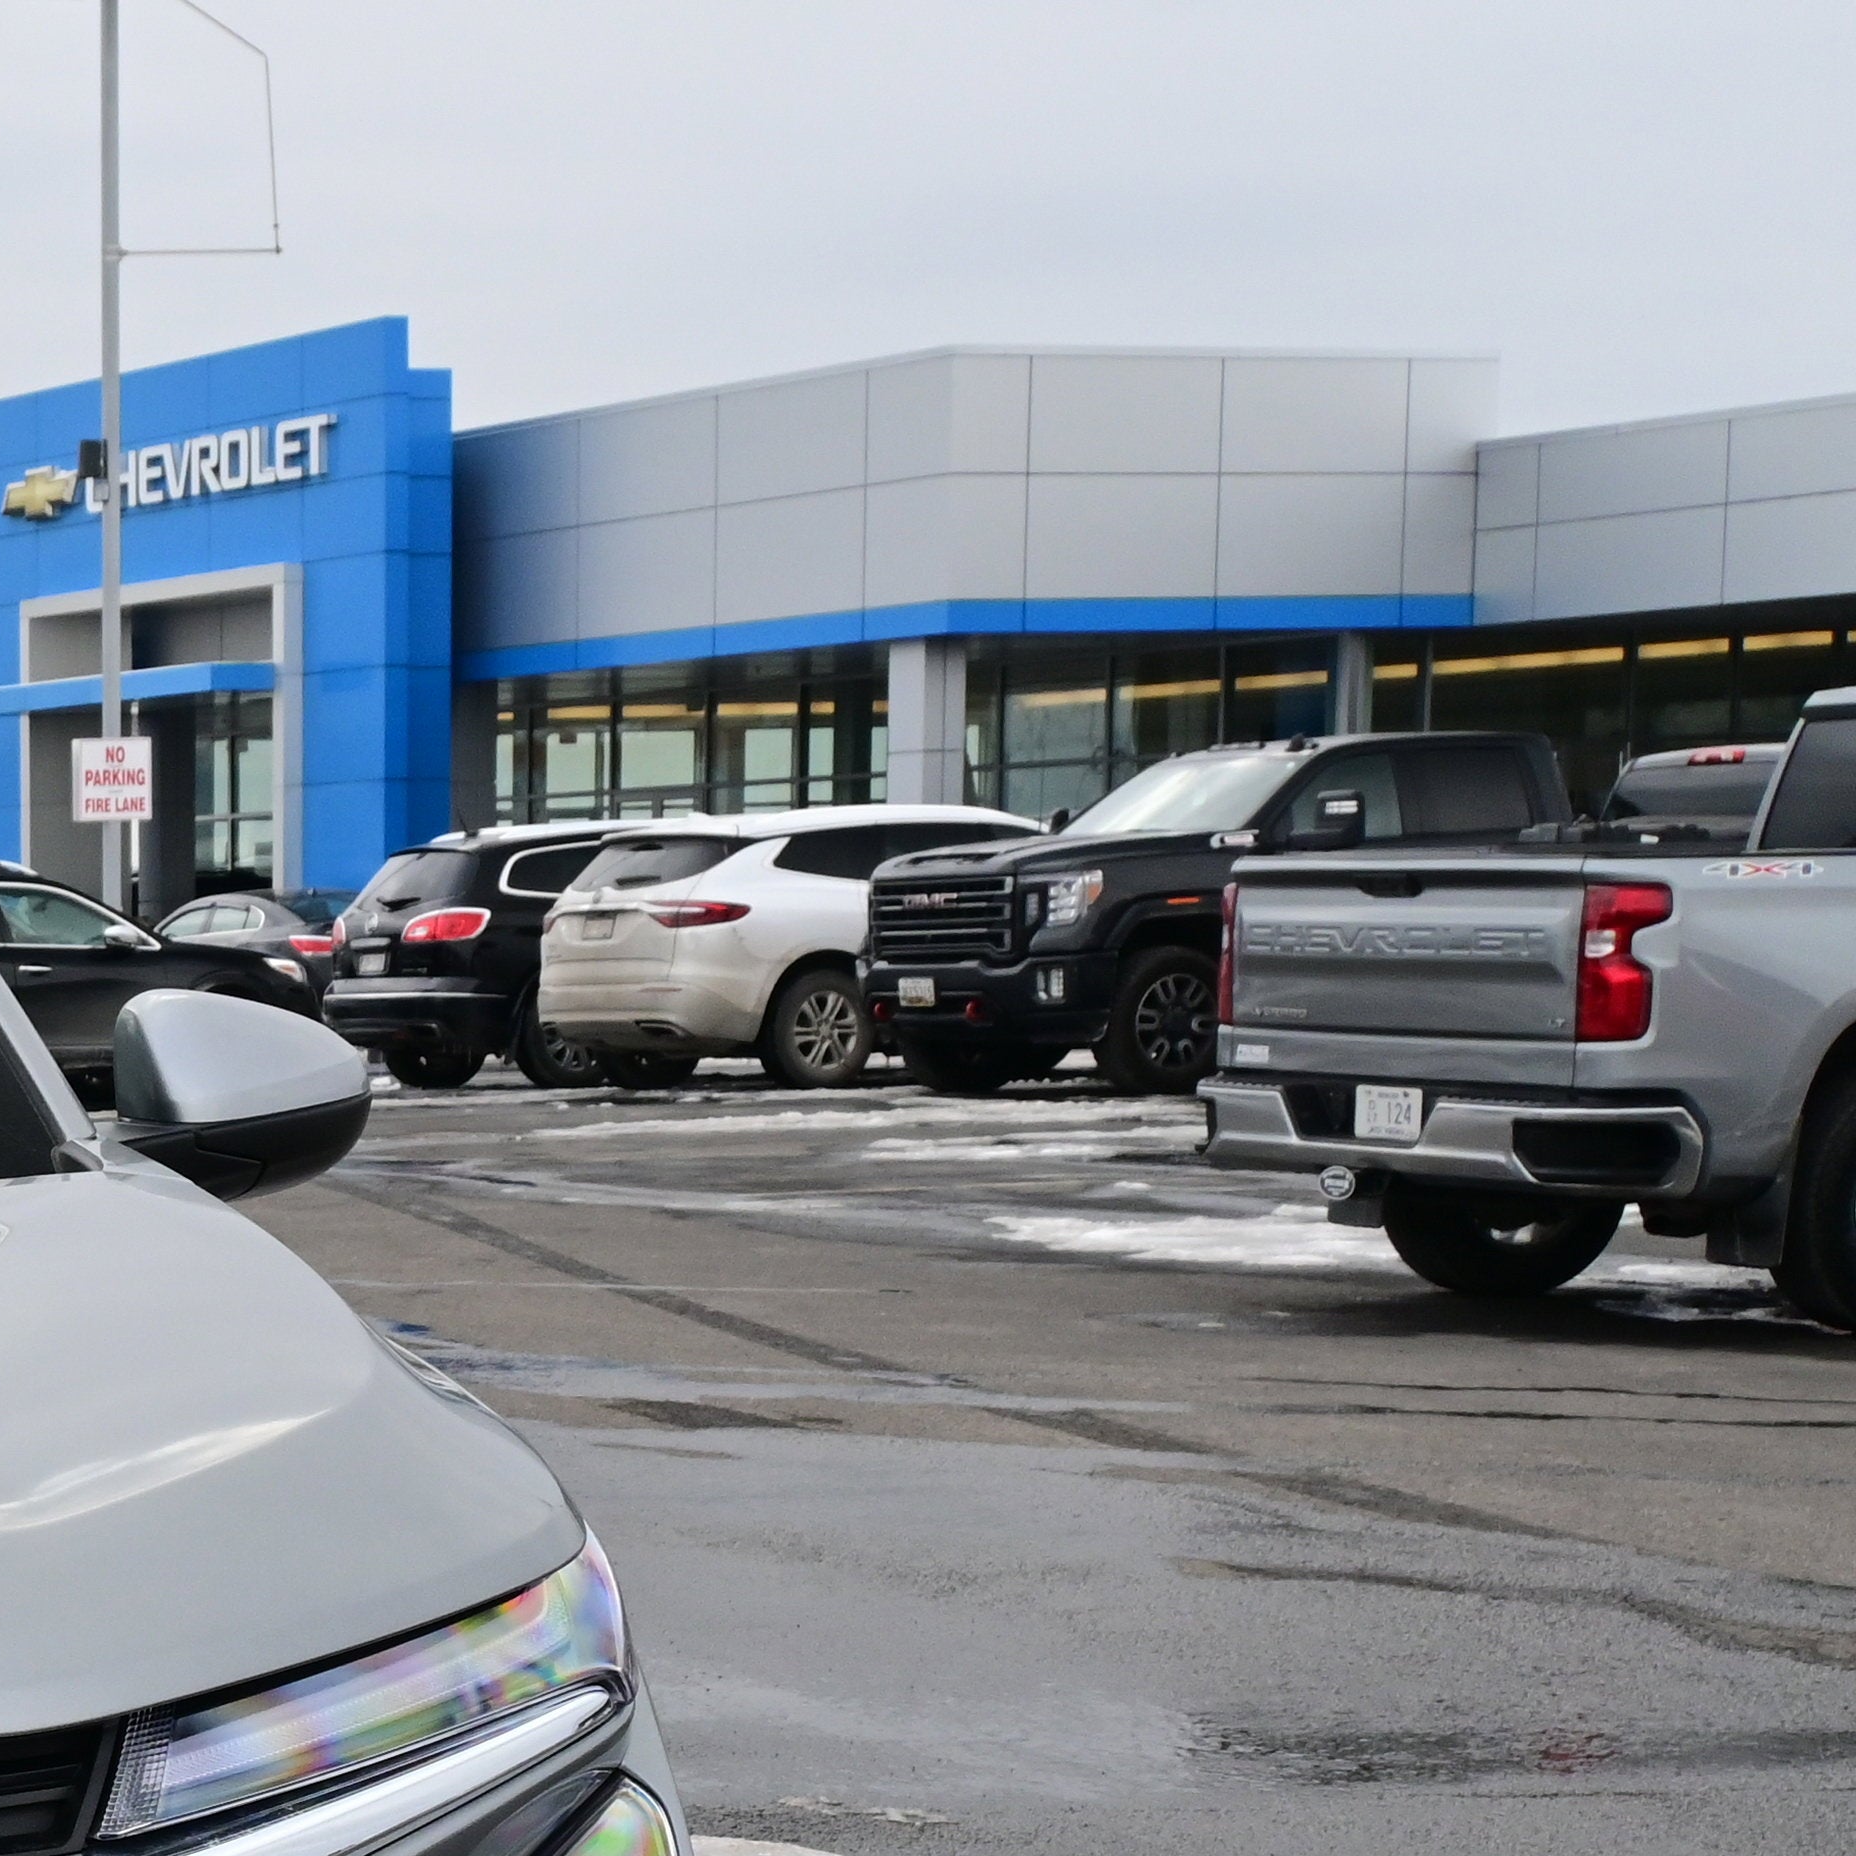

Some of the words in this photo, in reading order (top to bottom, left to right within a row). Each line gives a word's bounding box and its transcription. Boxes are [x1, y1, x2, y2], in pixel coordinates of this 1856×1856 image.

[105, 746, 126, 763] NO
[84, 768, 145, 786] PARKING
[85, 798, 111, 813] FIRE
[115, 796, 146, 812] LANE
[1245, 923, 1546, 956] CHEVROLET
[1386, 1101, 1412, 1125] 124
